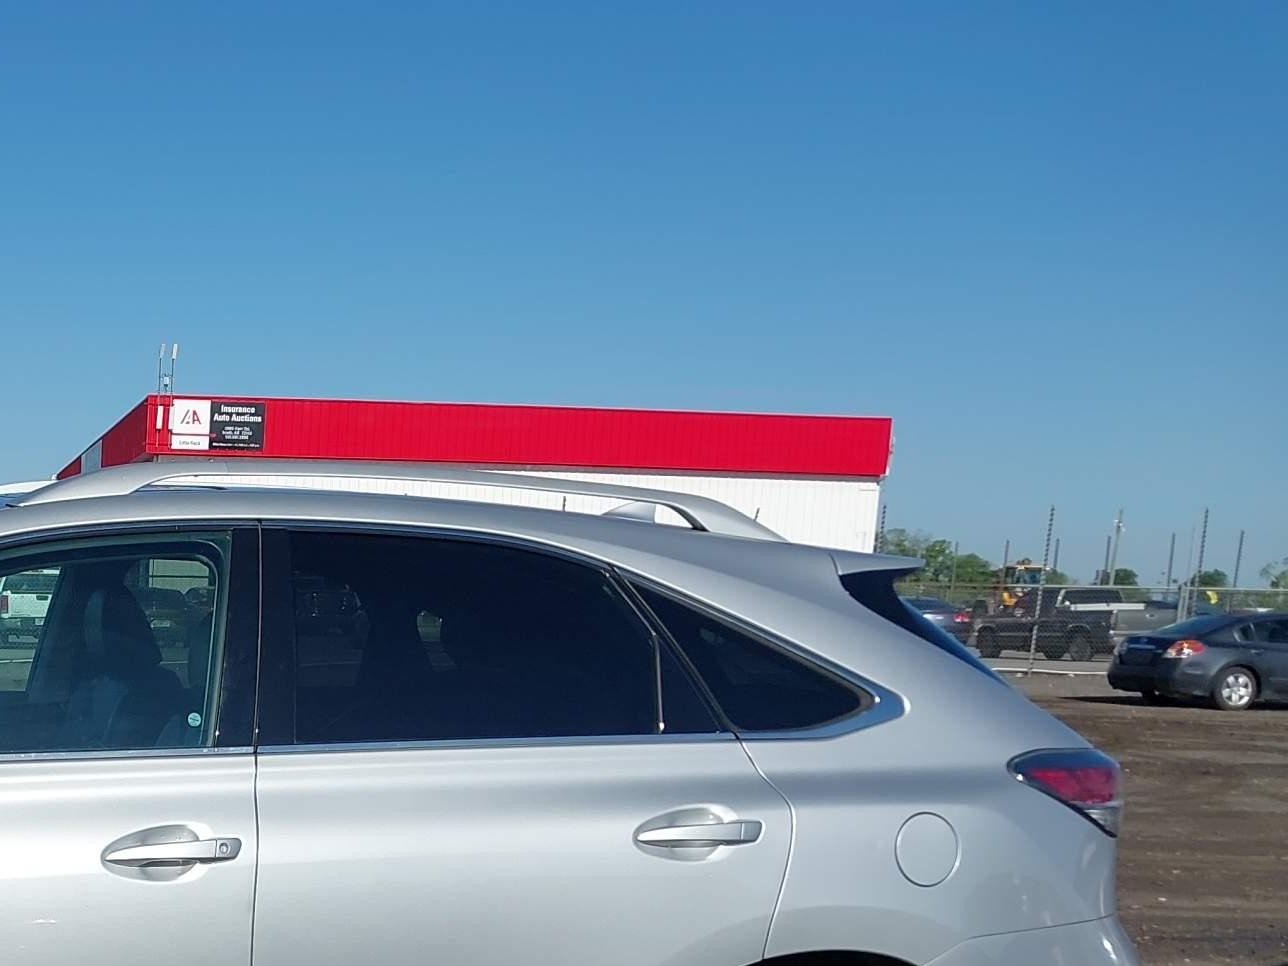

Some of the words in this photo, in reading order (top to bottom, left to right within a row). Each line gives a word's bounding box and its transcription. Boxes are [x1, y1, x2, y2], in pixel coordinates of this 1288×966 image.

[221, 404, 256, 413] Insurance
[213, 412, 230, 422] Auto
[231, 413, 262, 422] Auctions
